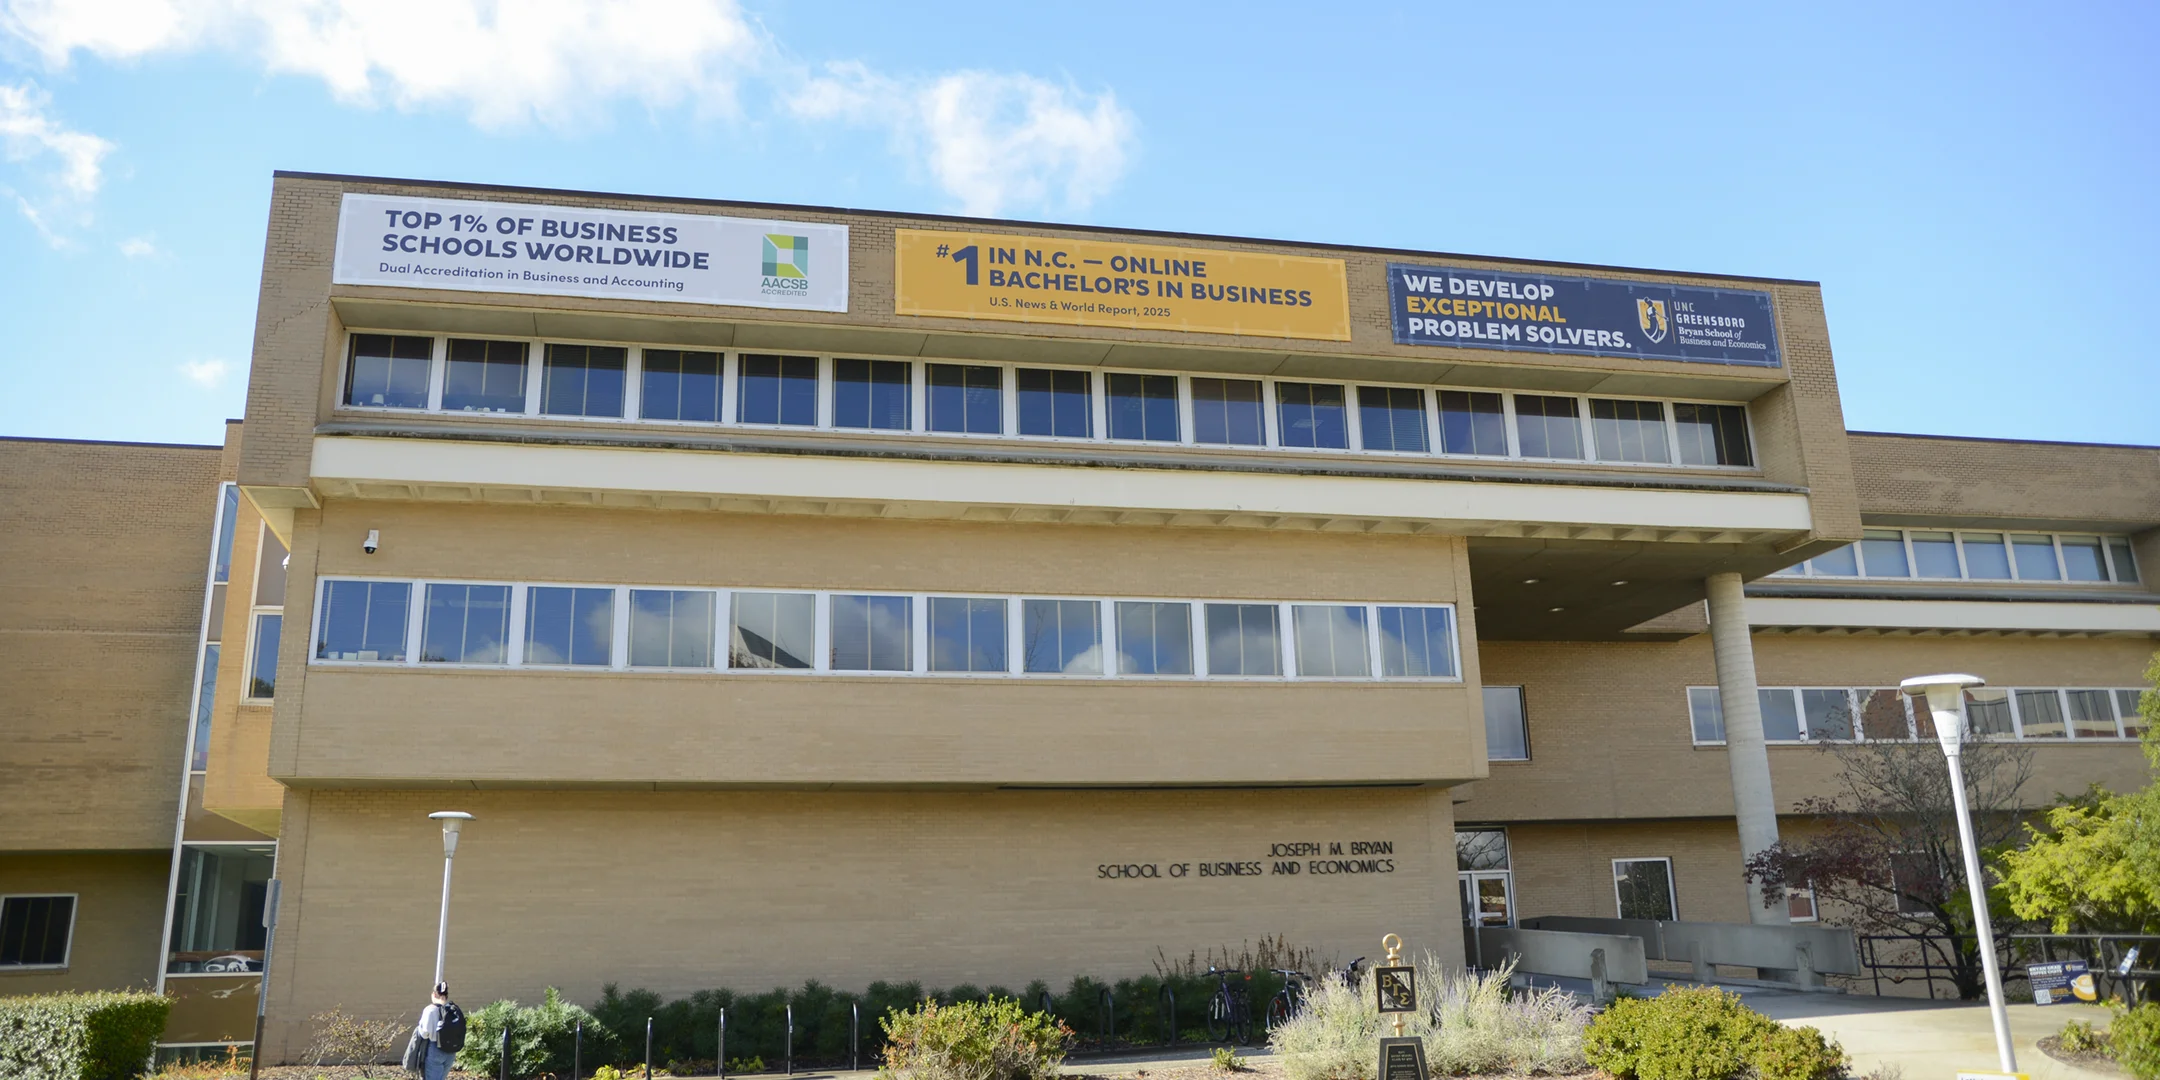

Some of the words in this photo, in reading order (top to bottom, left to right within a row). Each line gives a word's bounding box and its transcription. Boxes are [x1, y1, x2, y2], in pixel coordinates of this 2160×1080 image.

[386, 210, 442, 230] TOP
[449, 214, 488, 233] 1%
[496, 216, 534, 236] OF
[541, 220, 678, 244] BUSINESS
[382, 234, 517, 258] SCHOOLS
[525, 242, 709, 270] WORLDWIDE
[936, 244, 978, 285] #1
[990, 247, 1015, 265] IN
[1025, 249, 1075, 268] N.C.
[1111, 255, 1206, 278] ONLINE
[379, 262, 410, 274] Dual
[414, 264, 503, 279] Accreditation
[508, 269, 518, 280] in
[524, 270, 579, 284] Business
[583, 275, 608, 285] and
[611, 276, 684, 292] Accounting
[761, 277, 808, 290] AACSB
[1403, 274, 1443, 293] WE
[1449, 278, 1554, 300] DEVELOP
[761, 289, 807, 297] ACCREDITED
[990, 270, 1150, 296] BACHELOR’S
[1157, 280, 1183, 298] IN
[1191, 283, 1312, 307] BUSINESS
[989, 297, 1012, 307] U.S.
[1016, 299, 1046, 309] News
[1050, 301, 1058, 310] &
[1060, 302, 1094, 312] World
[1098, 304, 1140, 317] Report,
[1144, 307, 1170, 317] 2025
[1406, 296, 1566, 323] EXCEPTIONAL
[1674, 301, 1694, 312] UNC
[1676, 313, 1745, 328] GREENSBORO
[1408, 317, 1520, 341] PROBLEM
[1526, 325, 1632, 348] SOLVERS.
[1678, 327, 1703, 337] Bryan
[1705, 328, 1733, 338] School
[1734, 331, 1742, 340] of
[1680, 336, 1711, 346] Business
[1728, 340, 1766, 350] Economics
[1268, 842, 1320, 858] JOSEPH
[1329, 842, 1344, 856] M.
[1351, 841, 1393, 856] BRYAN
[1097, 864, 1161, 879] SCHOOL
[1170, 863, 1190, 878] OF
[1200, 862, 1262, 877] BUSINESS
[1272, 861, 1300, 876] AND
[1309, 859, 1395, 875] ECONOMICS
